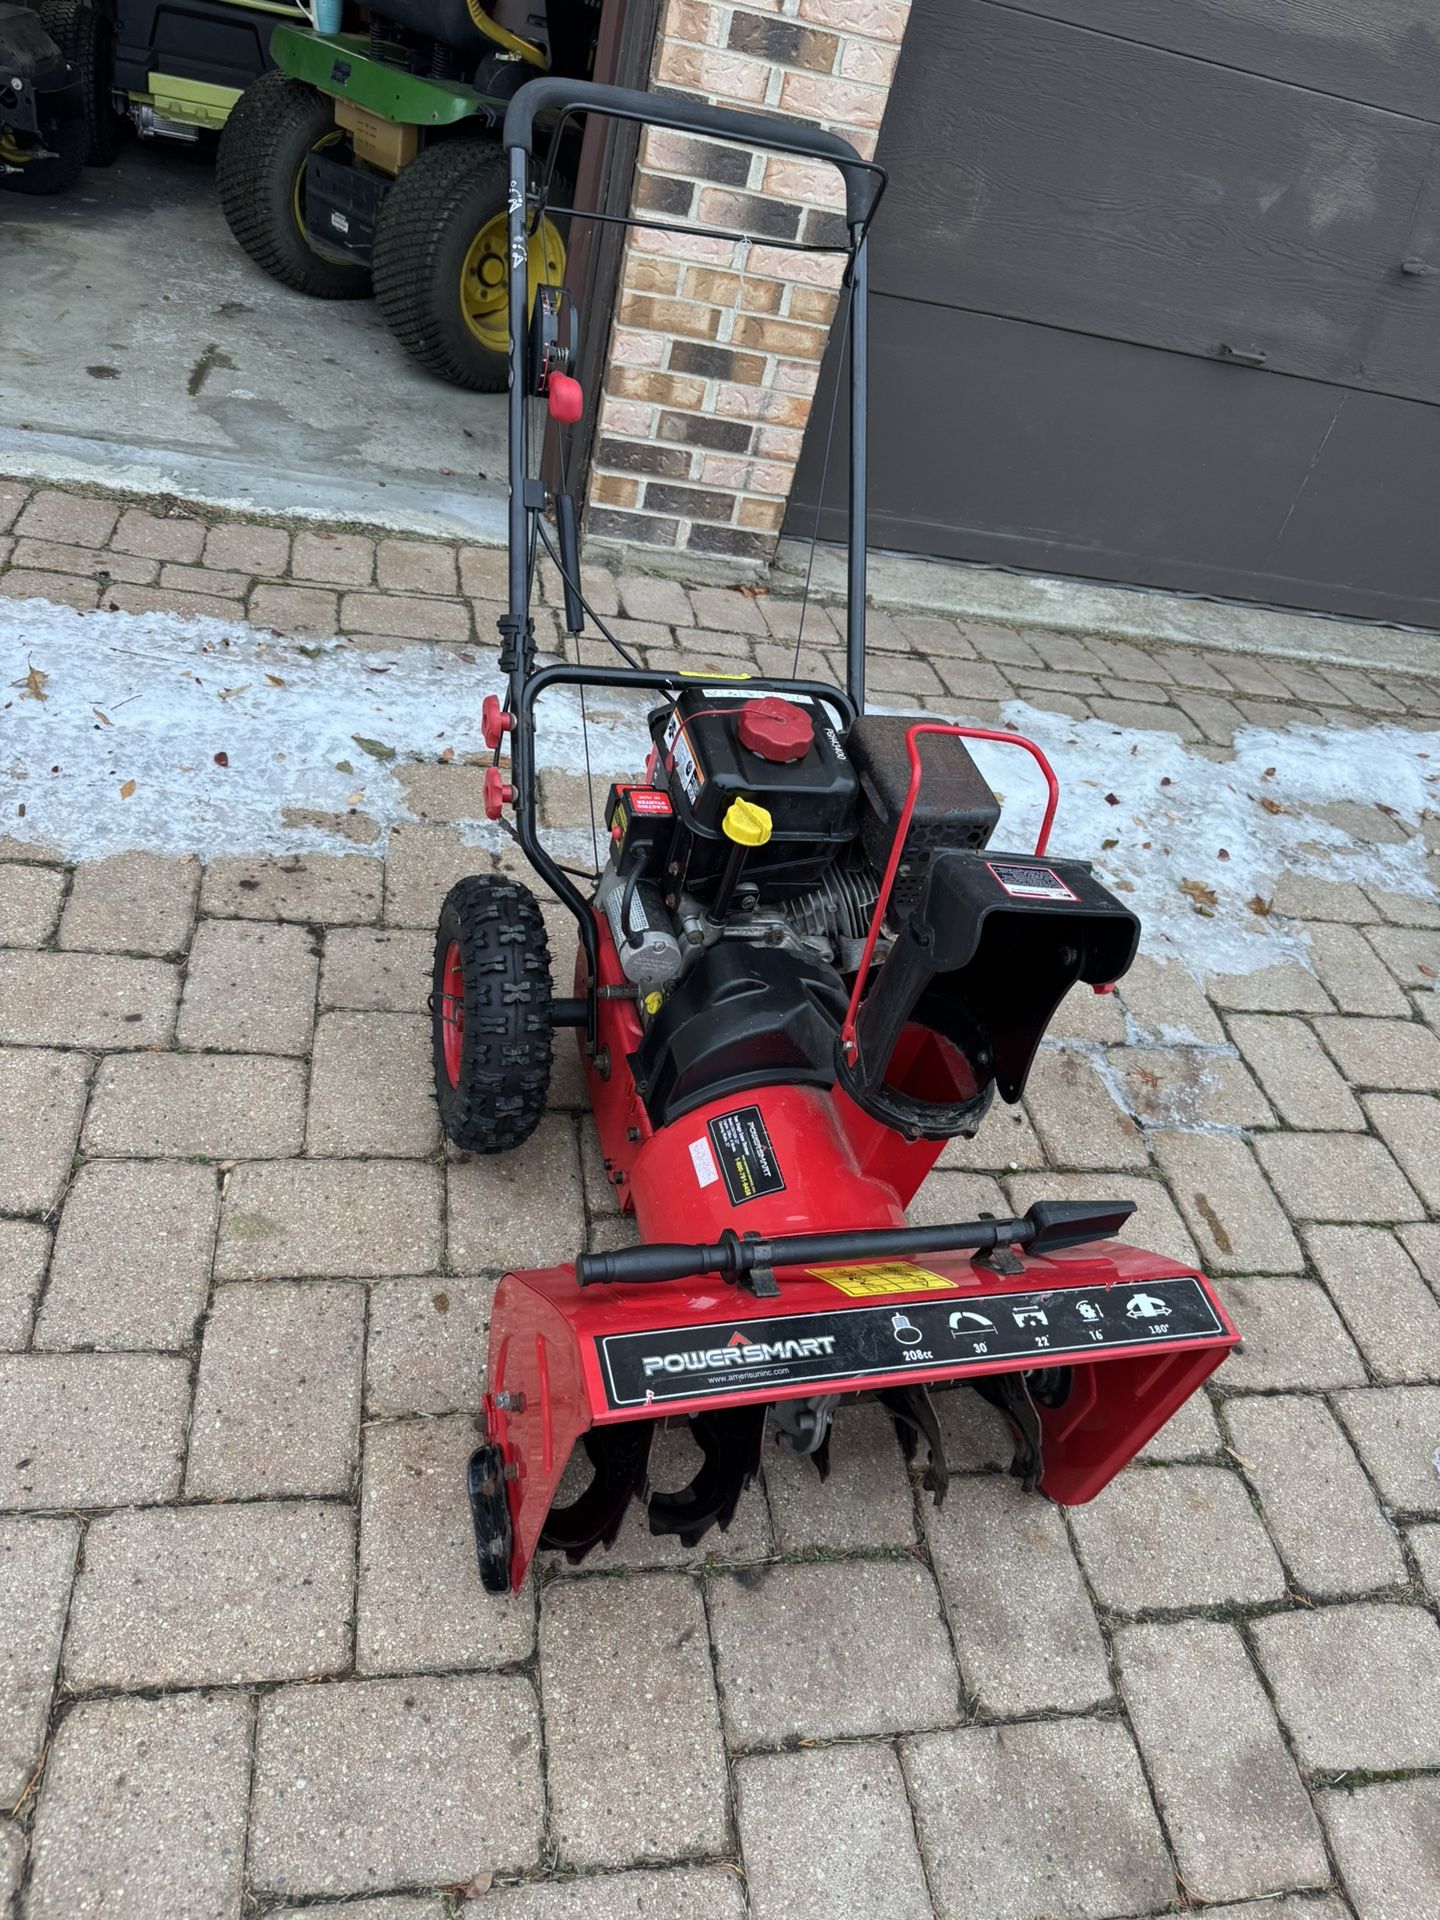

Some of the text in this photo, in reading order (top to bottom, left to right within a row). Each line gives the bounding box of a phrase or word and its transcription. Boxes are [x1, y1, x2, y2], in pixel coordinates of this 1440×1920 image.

[746, 1121, 771, 1177] POWERSMART
[642, 1335, 836, 1376] POWERSMART
[903, 1350, 933, 1361] 208cc
[707, 1367, 790, 1384] www.amerisuninc.com
